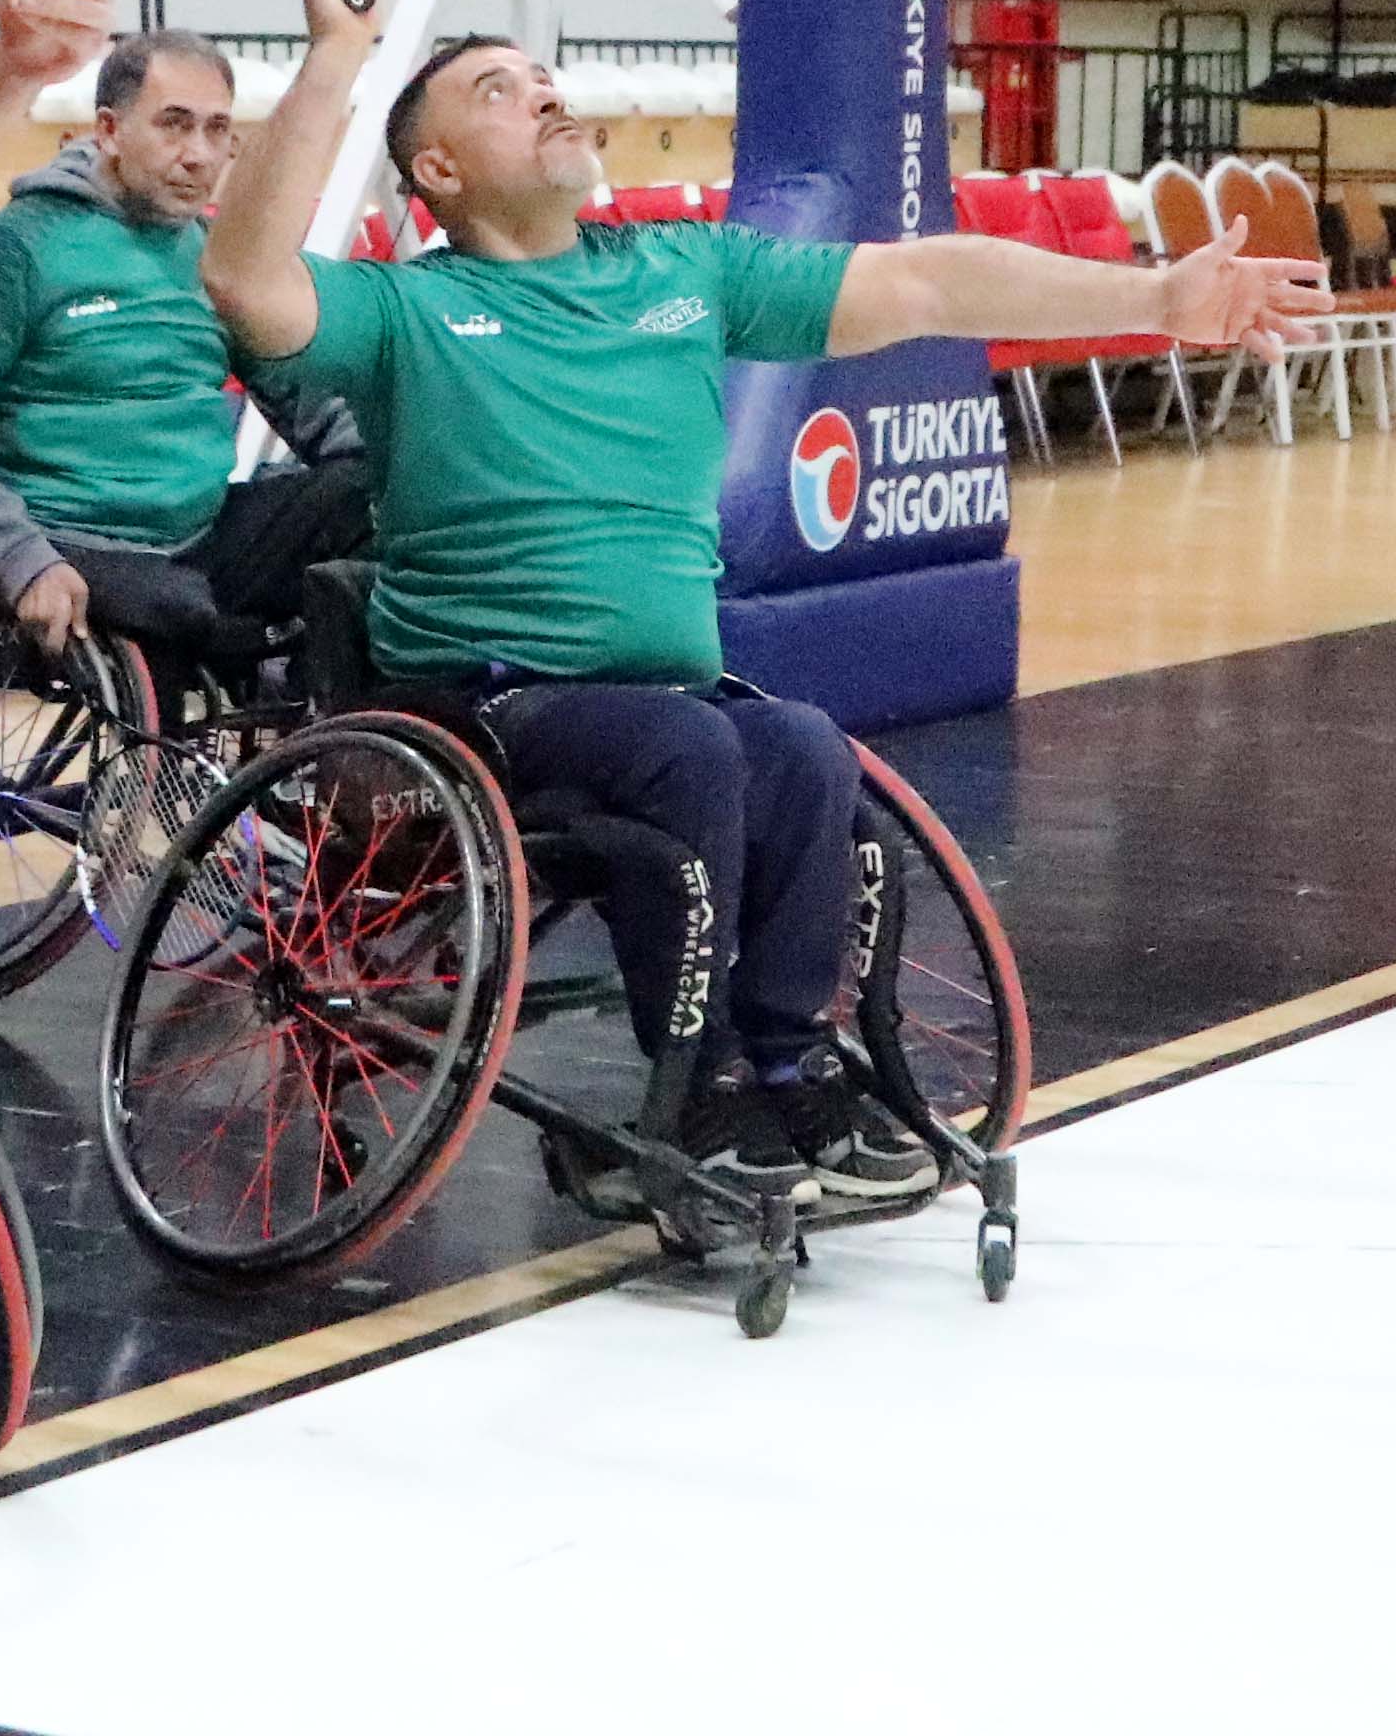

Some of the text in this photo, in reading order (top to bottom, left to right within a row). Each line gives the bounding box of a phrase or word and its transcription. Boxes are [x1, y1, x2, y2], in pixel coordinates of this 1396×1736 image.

[868, 395, 1007, 466] TÜRKİYE
[864, 465, 1009, 541] SİGORTA
[668, 862, 701, 1036] THE WHEELCHAIR
